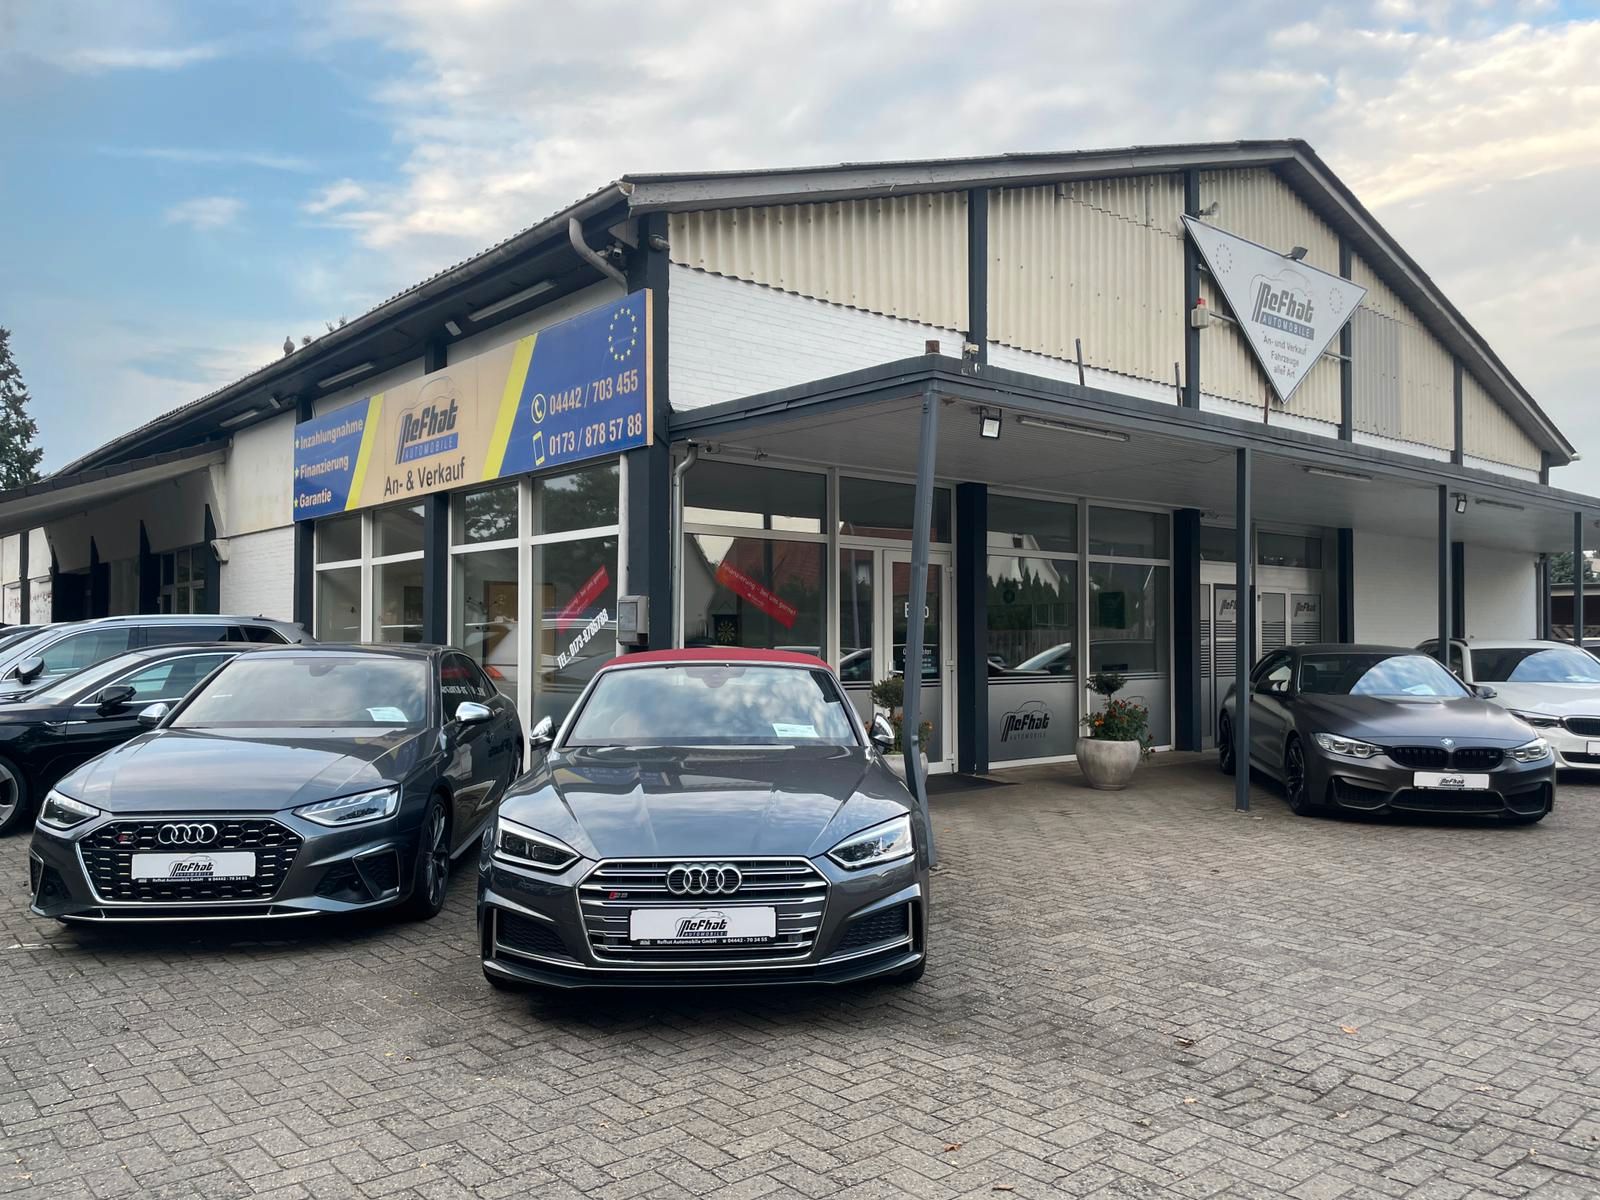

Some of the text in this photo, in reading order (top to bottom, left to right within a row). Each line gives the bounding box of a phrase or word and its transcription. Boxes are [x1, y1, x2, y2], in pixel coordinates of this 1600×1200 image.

[1261, 313, 1311, 338] AUTOMOBILE
[550, 387, 582, 415] 04442
[592, 377, 613, 402] 703
[616, 369, 638, 395] 455
[300, 418, 364, 449] Inzahlungnahme
[549, 430, 575, 456] 0173
[585, 421, 606, 448] 878
[609, 417, 624, 442] 57
[627, 412, 642, 438] 88
[404, 439, 454, 460] AUTOMOBILE
[300, 455, 349, 479] Finanzierung
[384, 456, 466, 497] An- & Verkauf
[300, 488, 332, 508] Garantie
[569, 607, 609, 657] 0173-8785788
